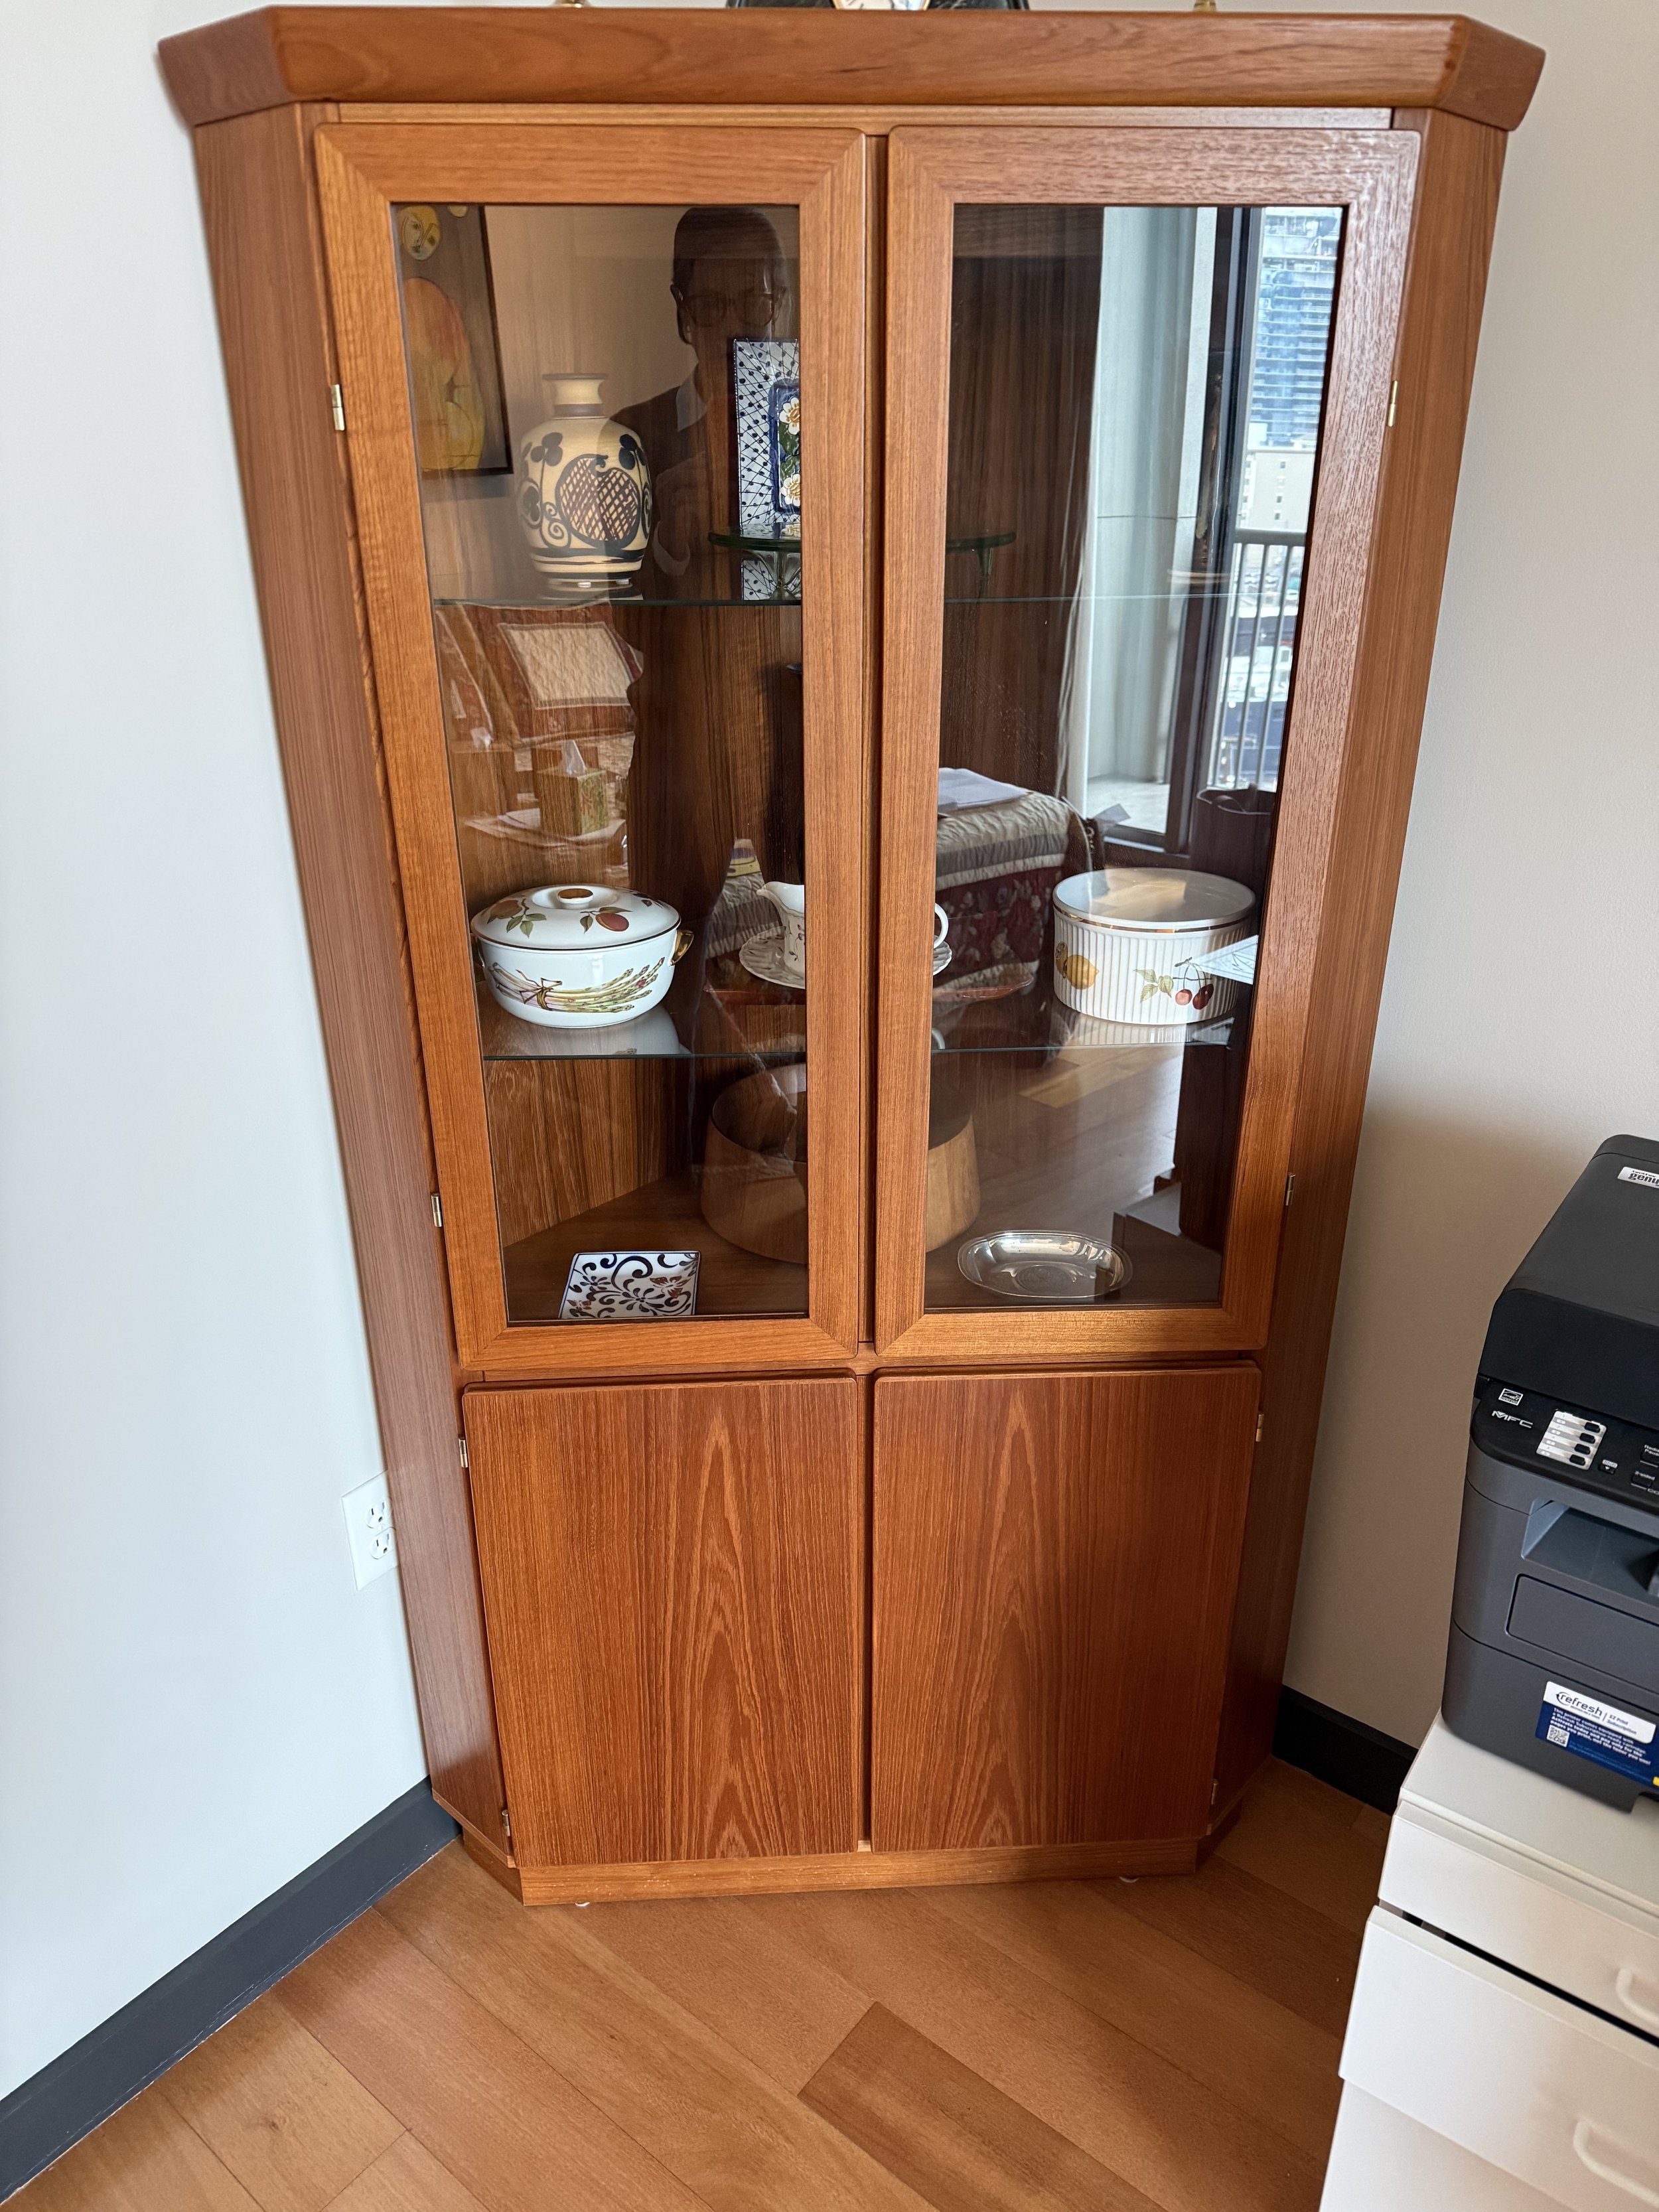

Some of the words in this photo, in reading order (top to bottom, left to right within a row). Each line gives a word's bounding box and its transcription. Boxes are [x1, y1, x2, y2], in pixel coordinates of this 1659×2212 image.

[1491, 1410, 1534, 1429] MFC
[1560, 1694, 1603, 1716] refresh
[1551, 1716, 1573, 1728] Activate
[1563, 1712, 1581, 1722] printer
